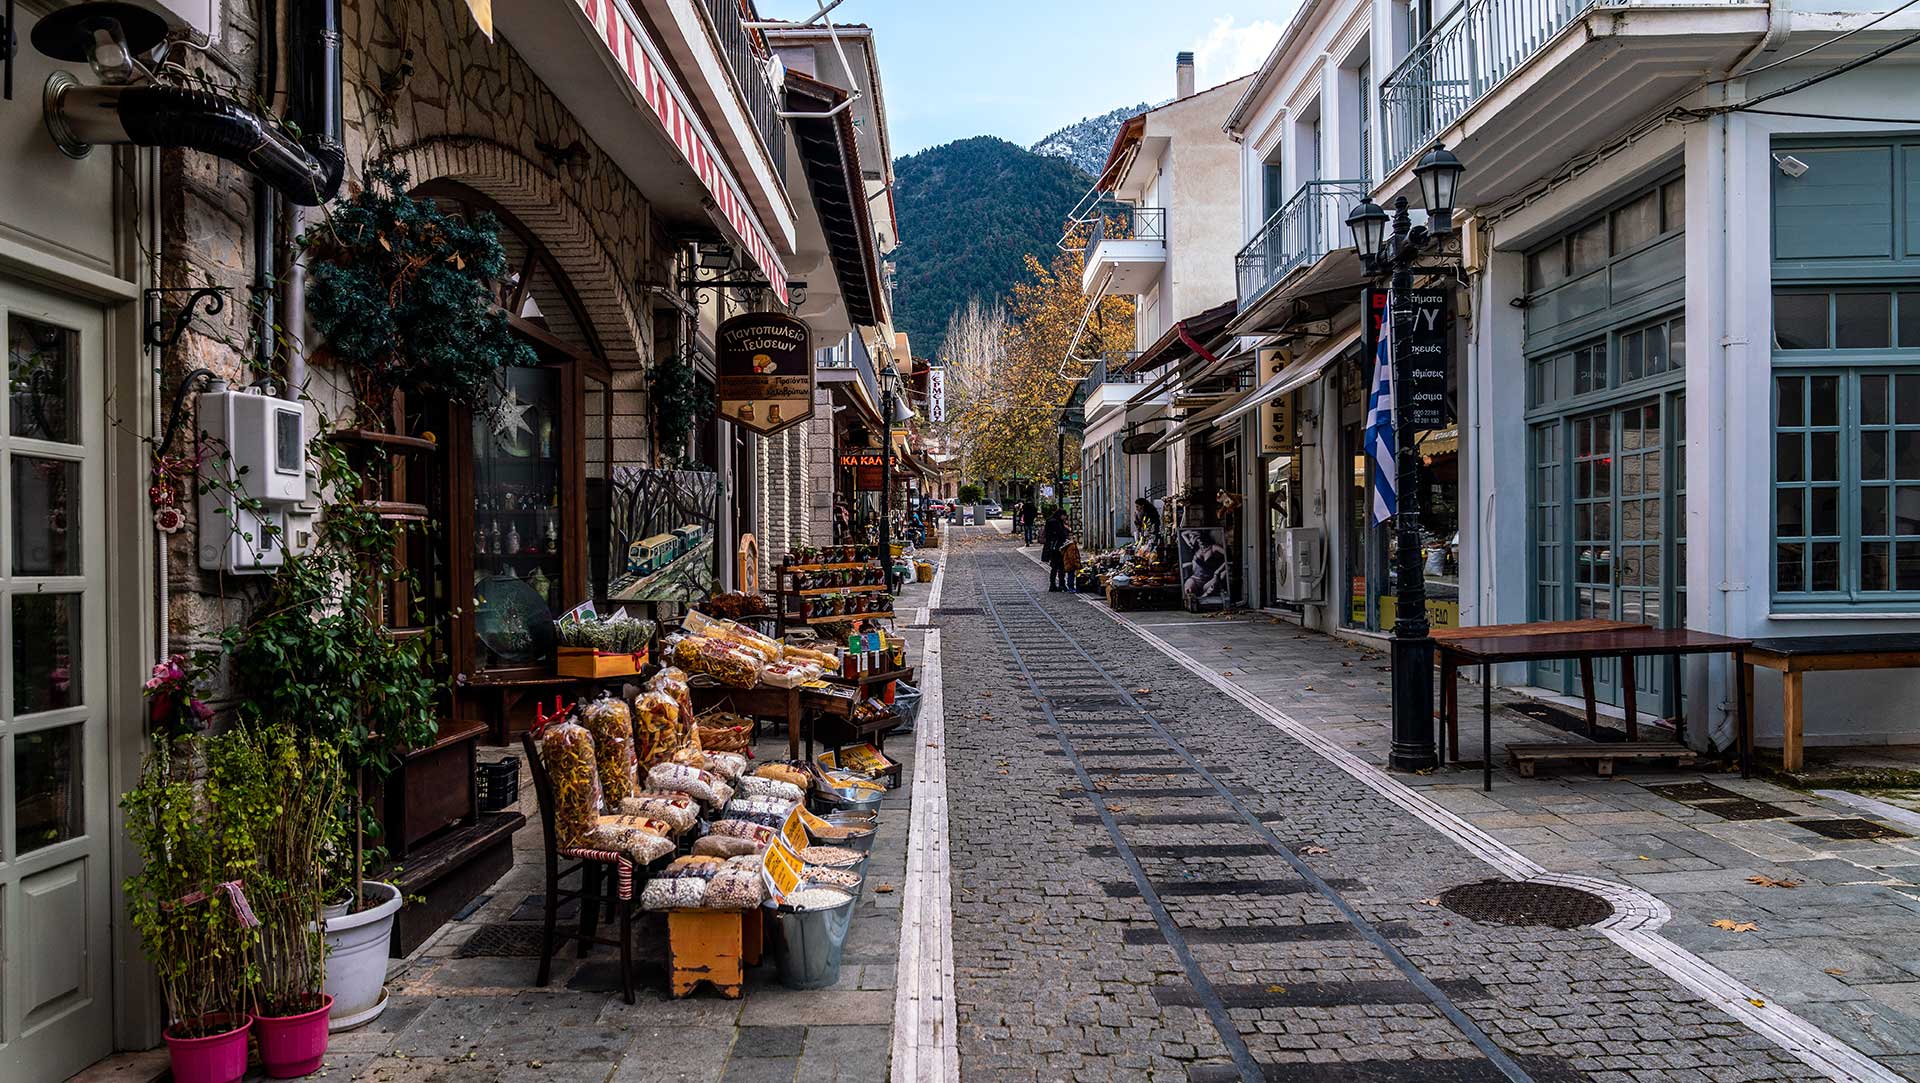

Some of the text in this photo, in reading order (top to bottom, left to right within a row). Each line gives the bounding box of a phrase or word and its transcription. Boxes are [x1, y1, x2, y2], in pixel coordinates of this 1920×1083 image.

[724, 325, 805, 344] Παντοπωλείο
[1411, 343, 1442, 354] κευές
[1412, 367, 1444, 379] θμίσεις
[1413, 390, 1443, 401] ώσιμα
